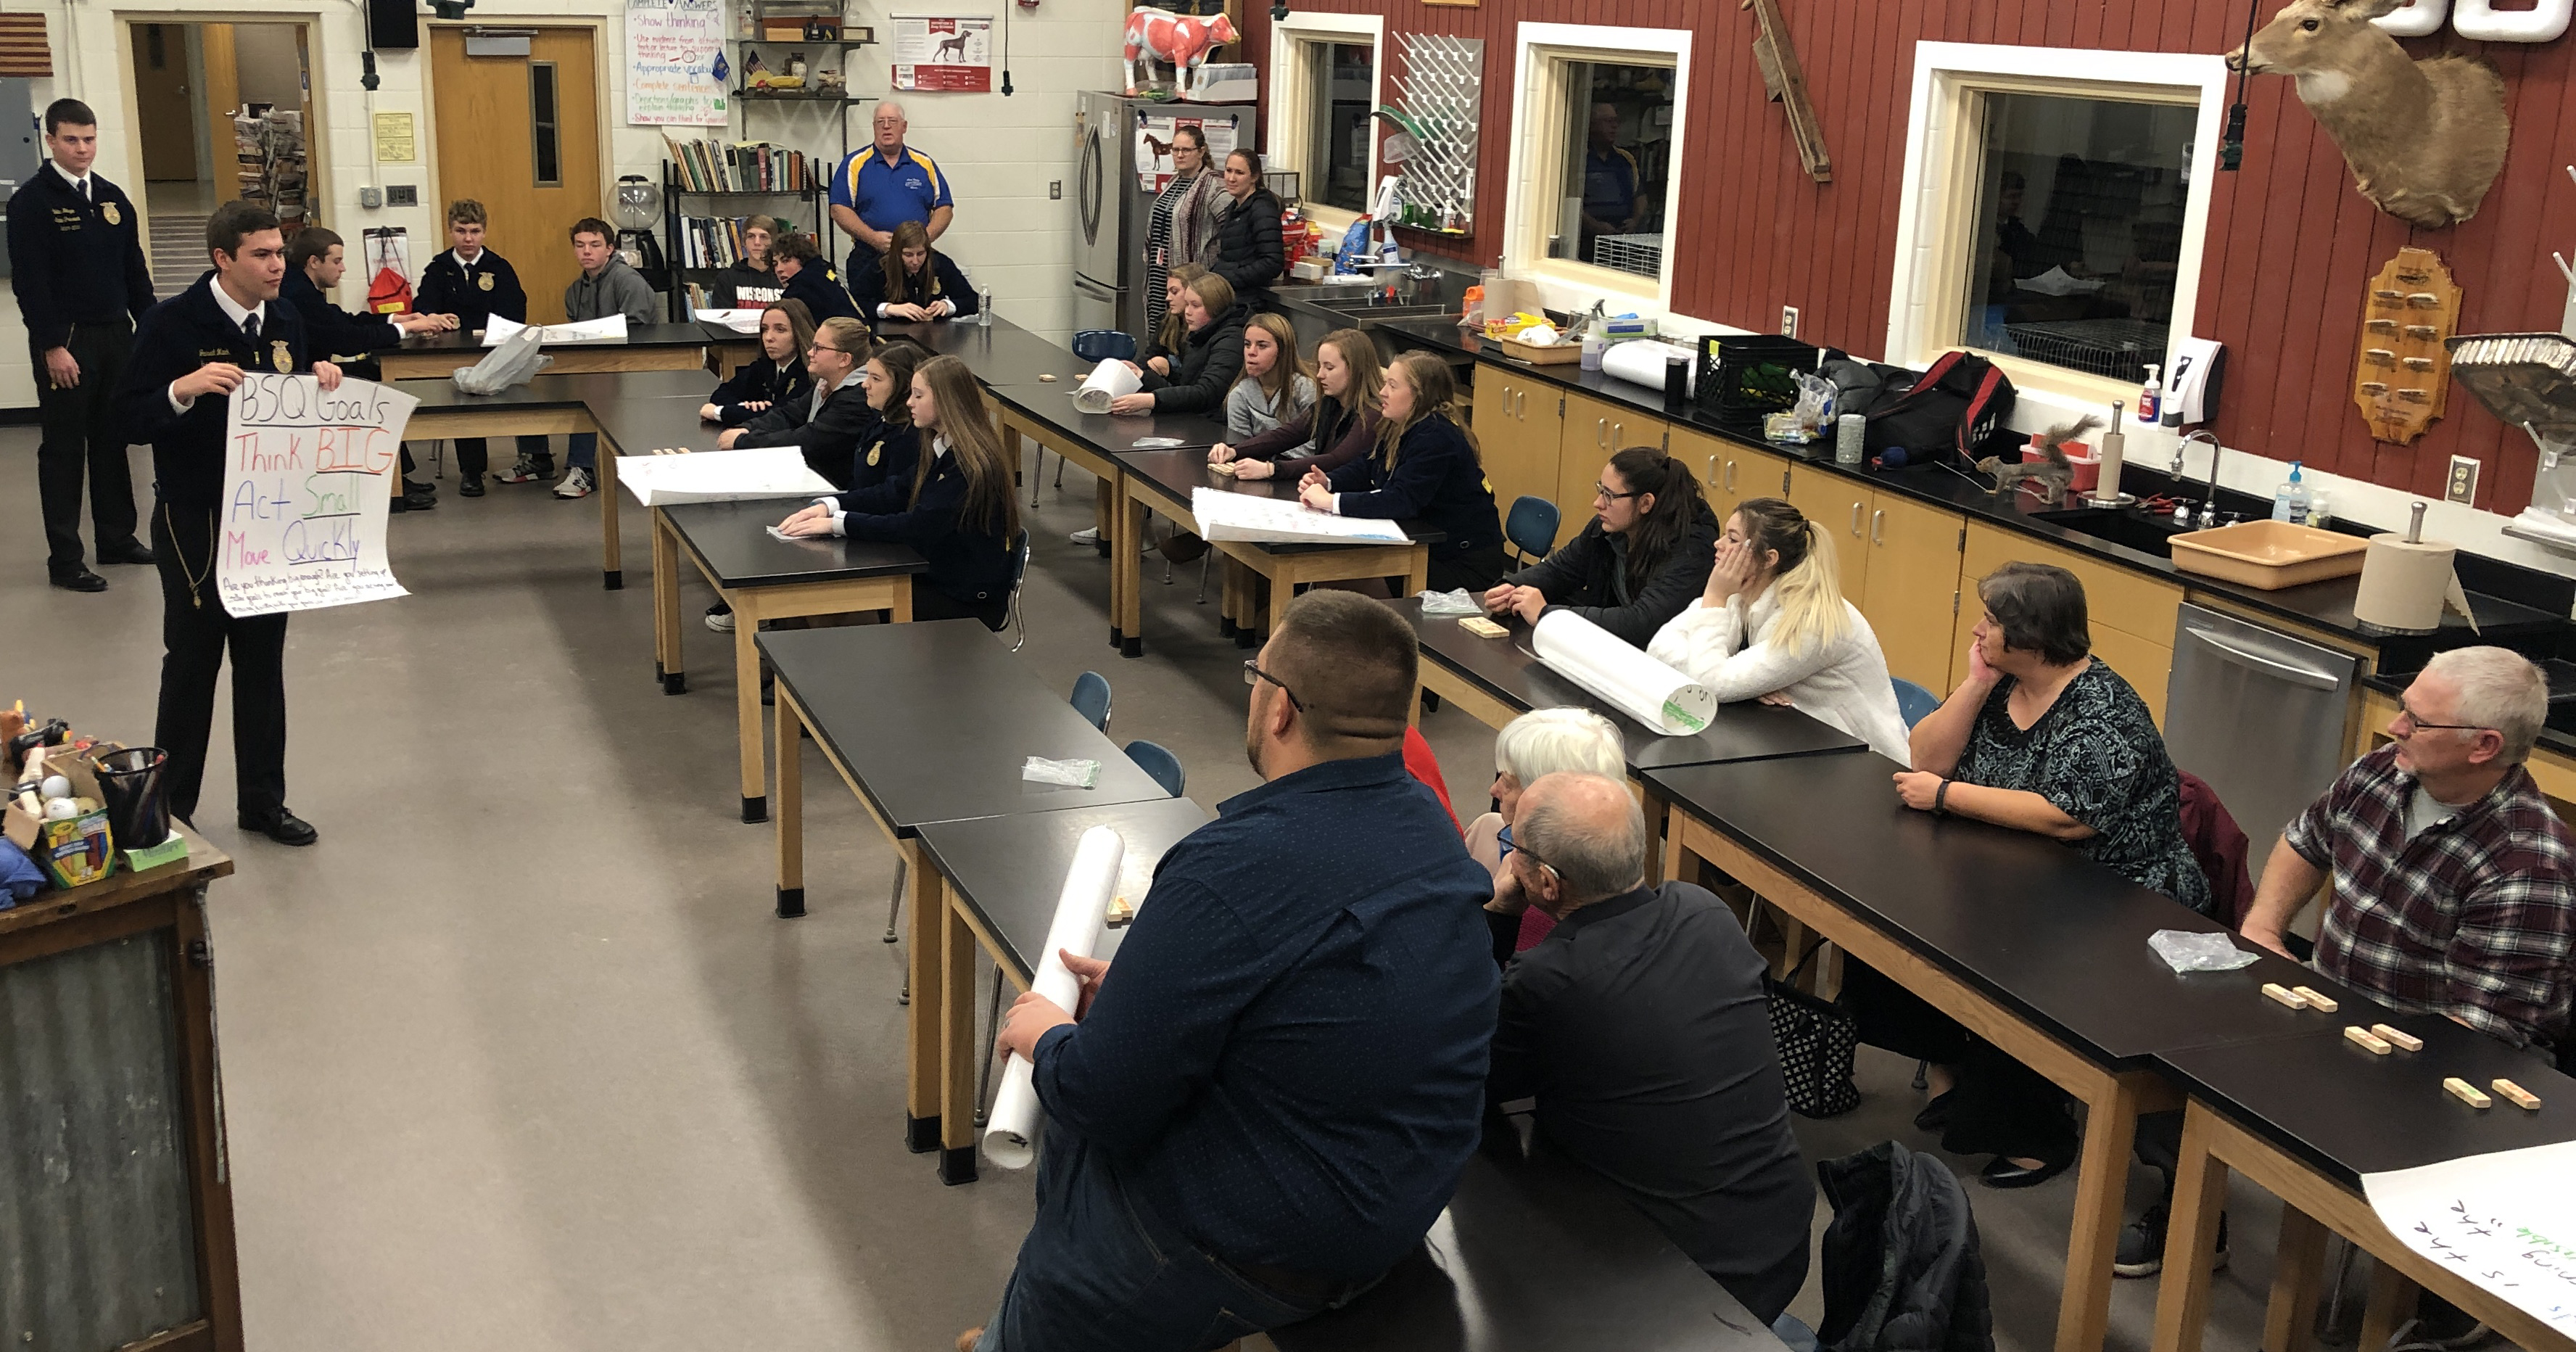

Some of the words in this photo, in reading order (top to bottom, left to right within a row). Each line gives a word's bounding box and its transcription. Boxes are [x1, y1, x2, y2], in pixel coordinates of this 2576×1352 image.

[637, 14, 662, 27] Show
[666, 12, 706, 38] thinking
[636, 61, 681, 76] Appropriate
[636, 78, 669, 92] Complete
[635, 113, 651, 122] Show
[240, 374, 306, 422] BSQ
[315, 384, 390, 424] Goals
[315, 427, 394, 472] BIG
[232, 477, 292, 524] Act
[301, 474, 361, 517] Small
[226, 530, 271, 570] Move
[2451, 1199, 2492, 1237] the
[2414, 1221, 2469, 1262] the
